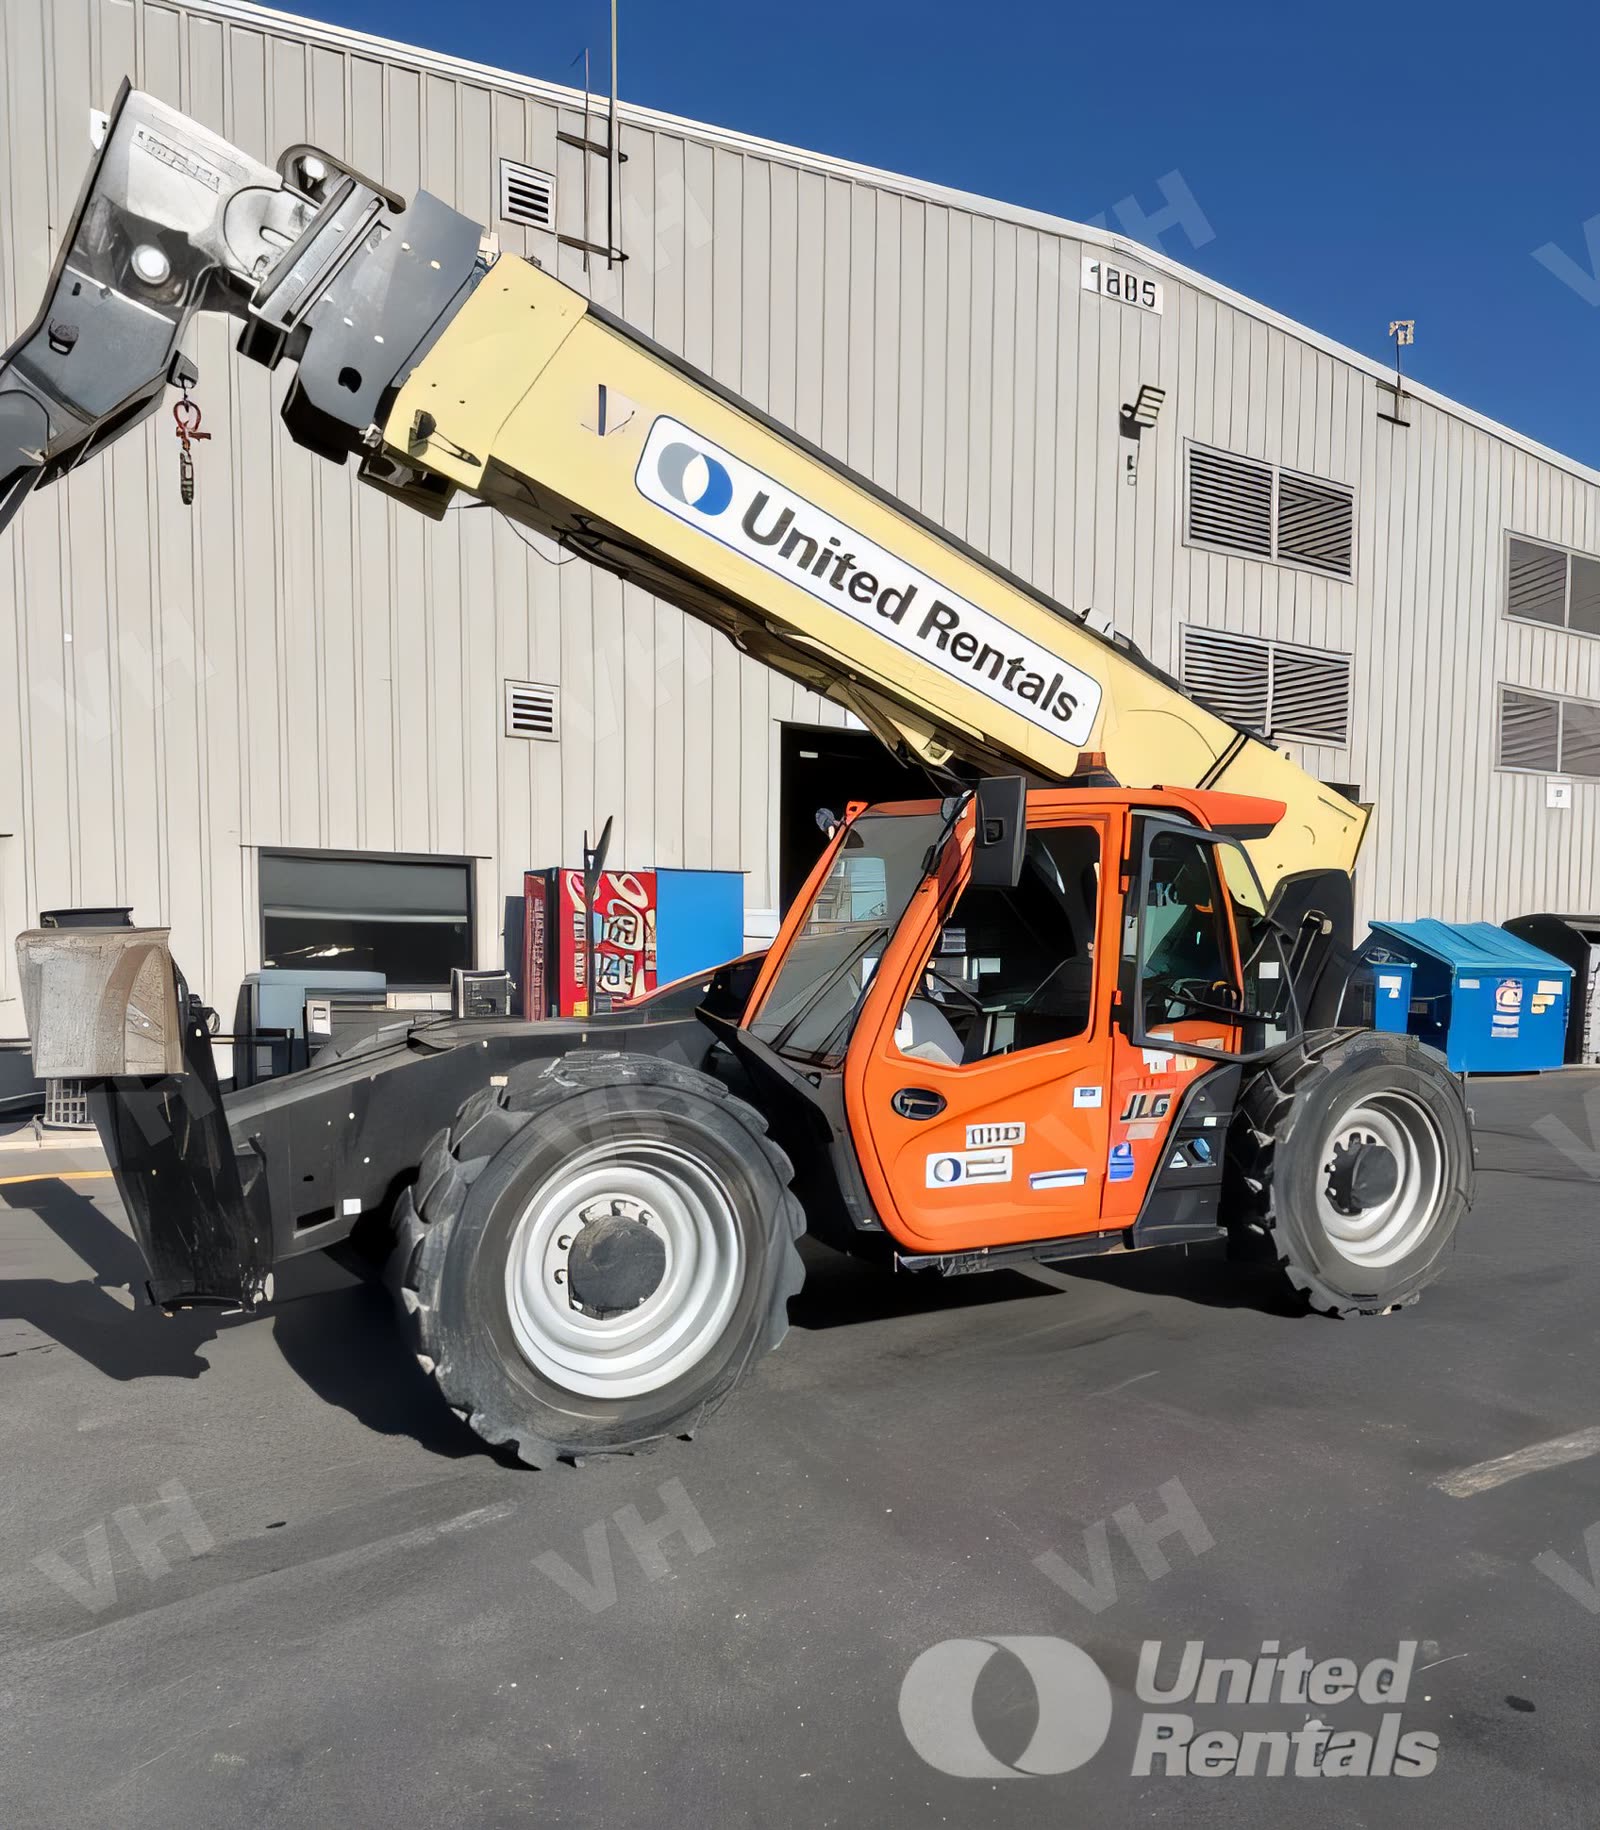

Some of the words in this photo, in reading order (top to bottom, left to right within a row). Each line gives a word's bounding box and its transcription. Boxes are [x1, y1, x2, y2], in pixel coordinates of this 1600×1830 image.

[742, 491, 917, 624] United
[916, 600, 1078, 723] Rentals
[1120, 1093, 1171, 1121] JLG
